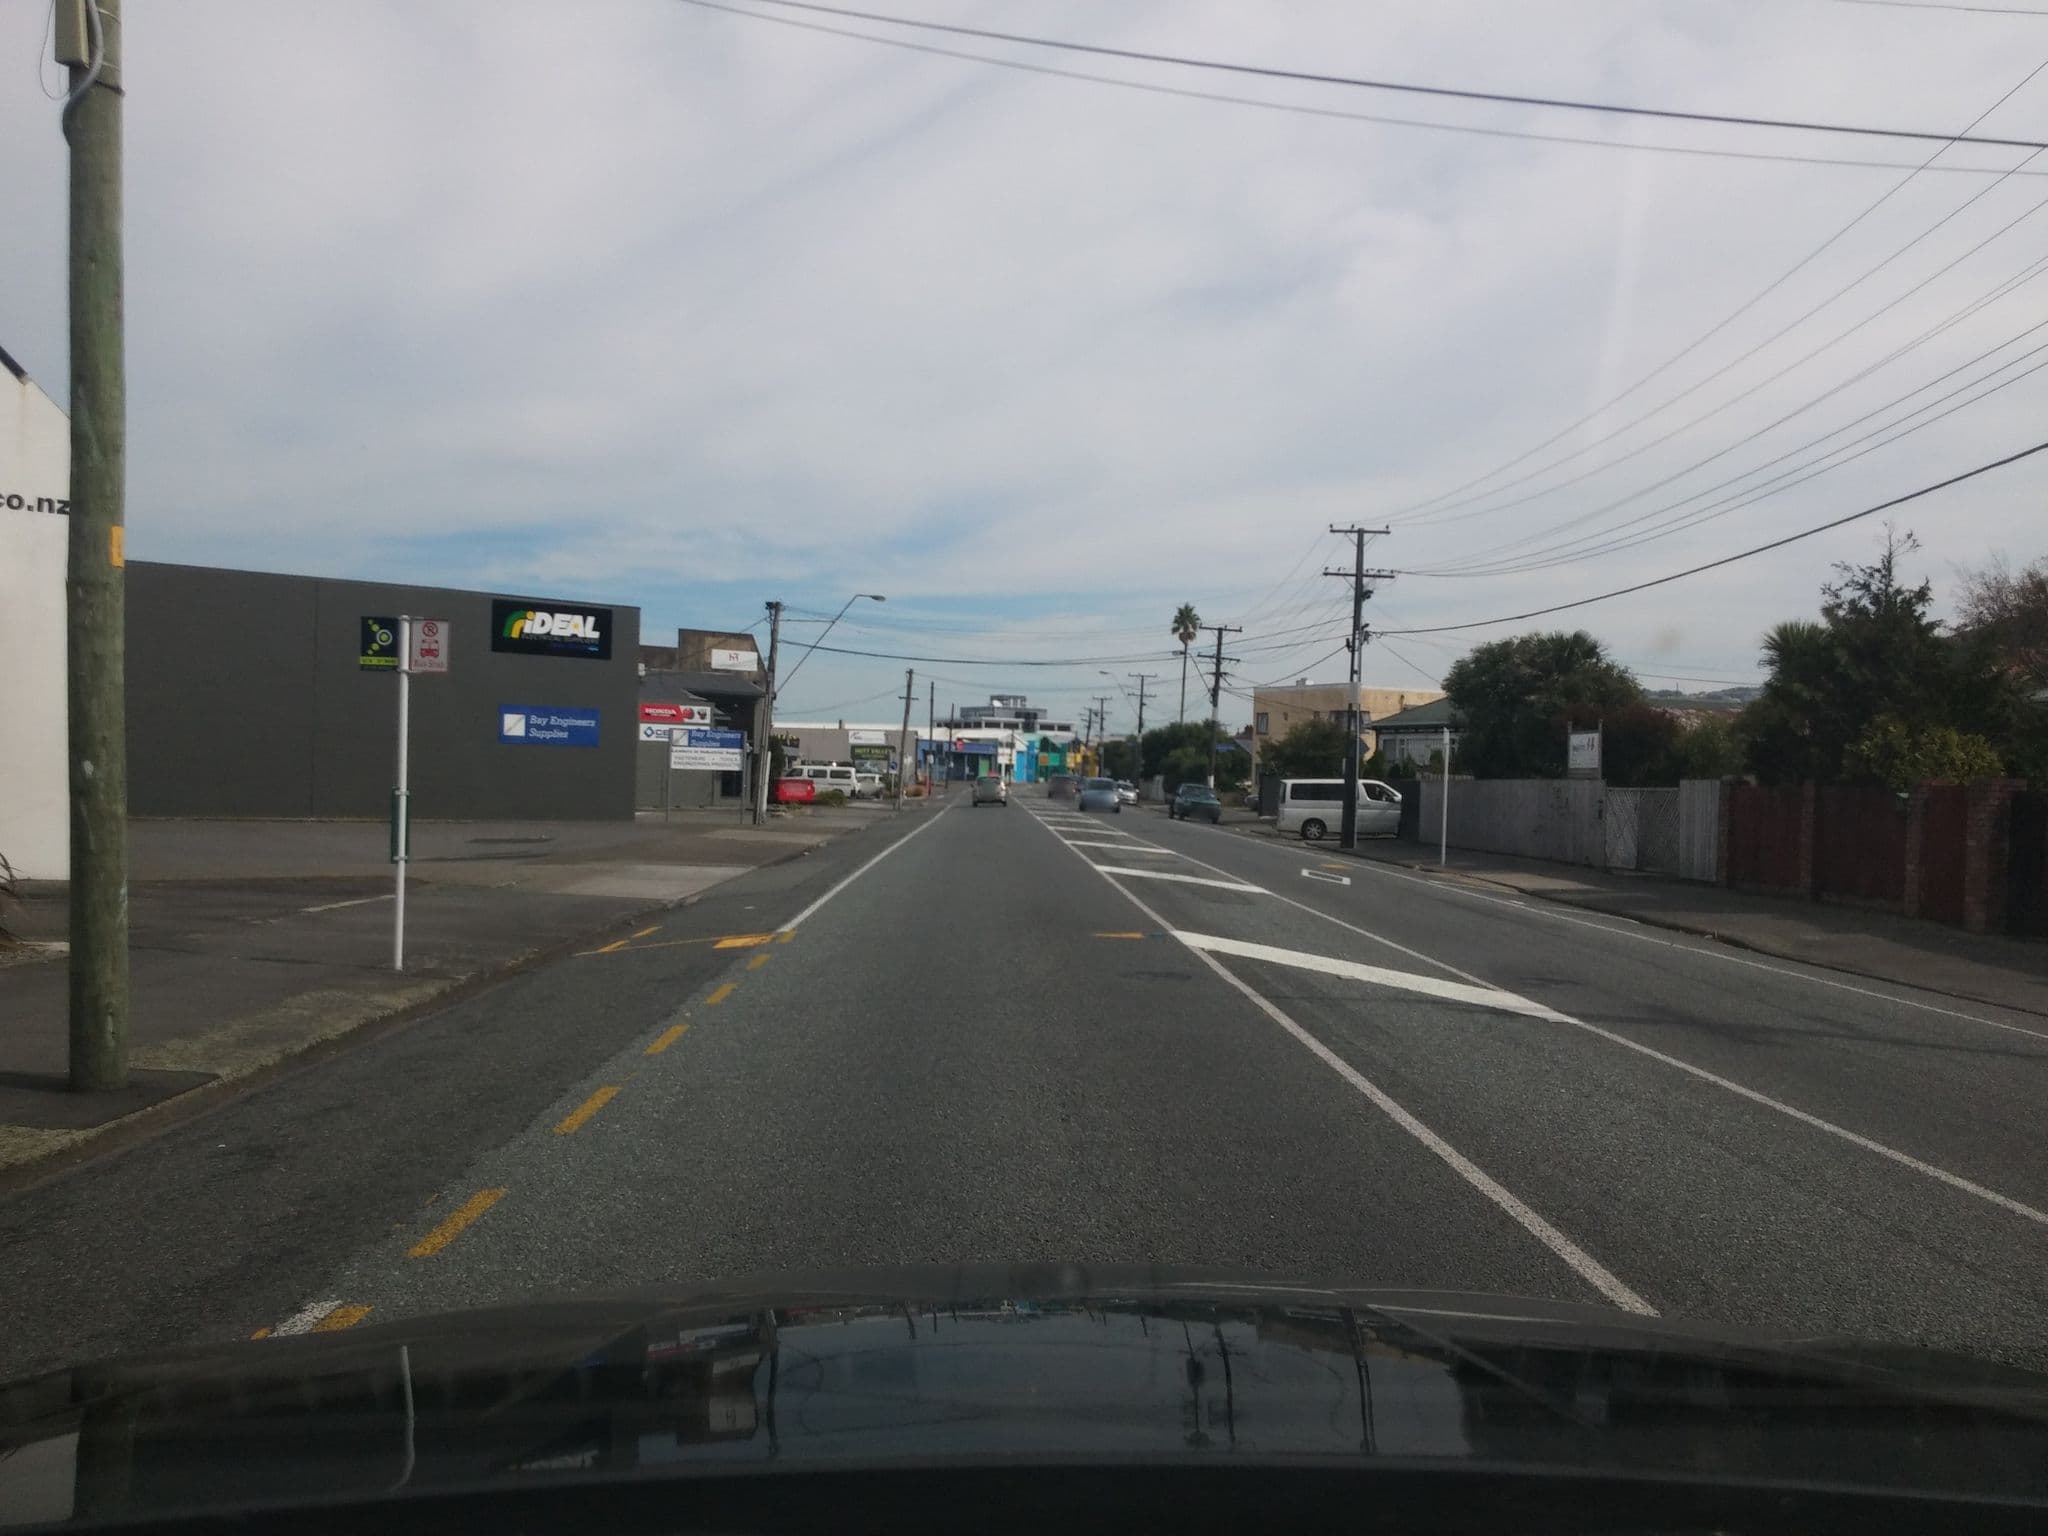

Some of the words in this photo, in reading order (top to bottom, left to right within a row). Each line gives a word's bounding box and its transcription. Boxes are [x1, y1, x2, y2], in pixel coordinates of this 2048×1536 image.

[529, 714, 548, 727] Bay
[549, 715, 596, 728] Engineers
[529, 728, 568, 740] Supplies
